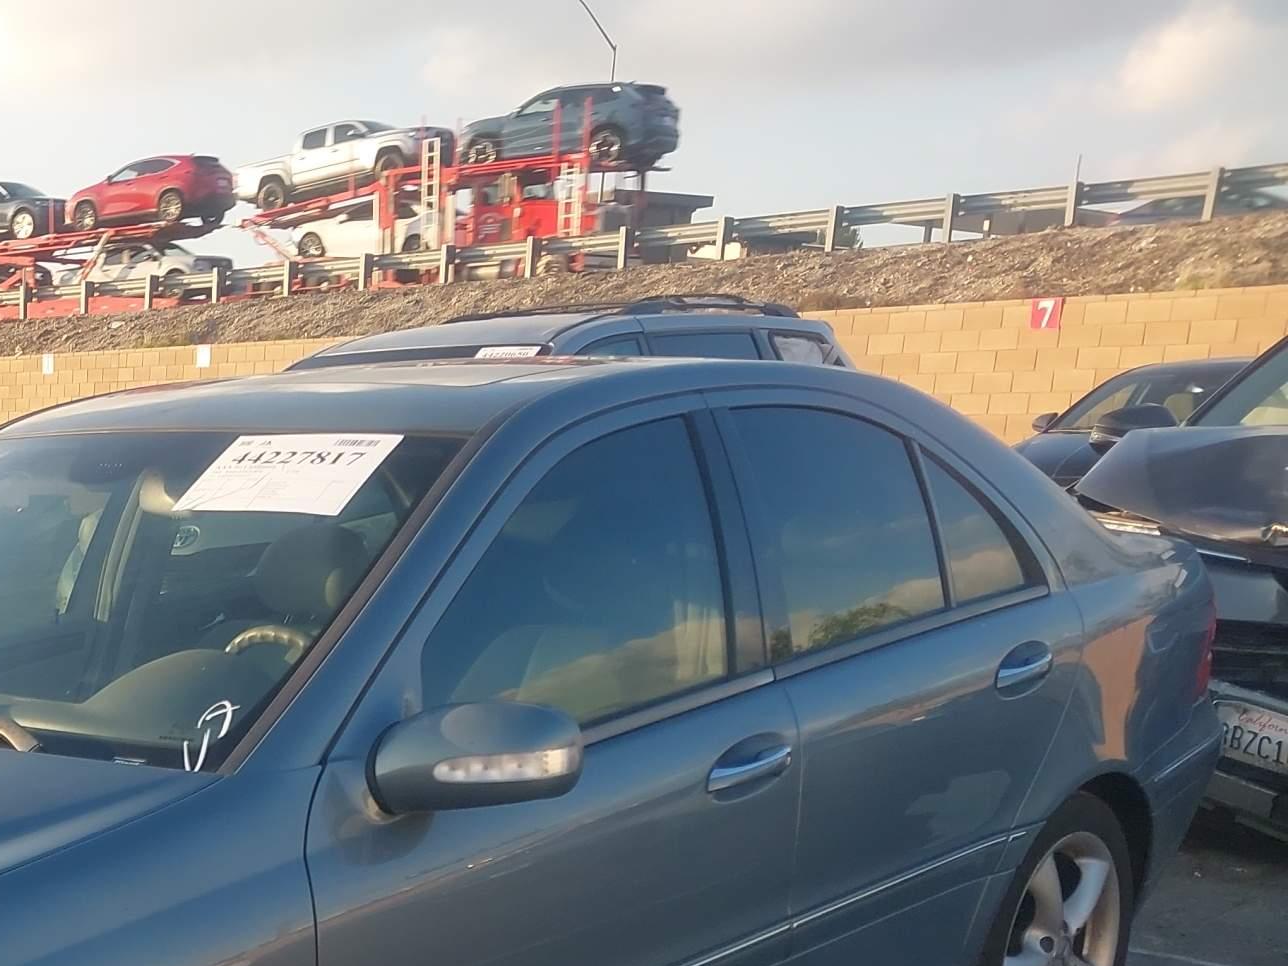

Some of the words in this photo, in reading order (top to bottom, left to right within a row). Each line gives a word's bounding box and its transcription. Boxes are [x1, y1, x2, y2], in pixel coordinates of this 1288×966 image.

[1037, 300, 1055, 328] 7
[231, 451, 367, 467] 44227817
[1222, 721, 1288, 765] BZC1
